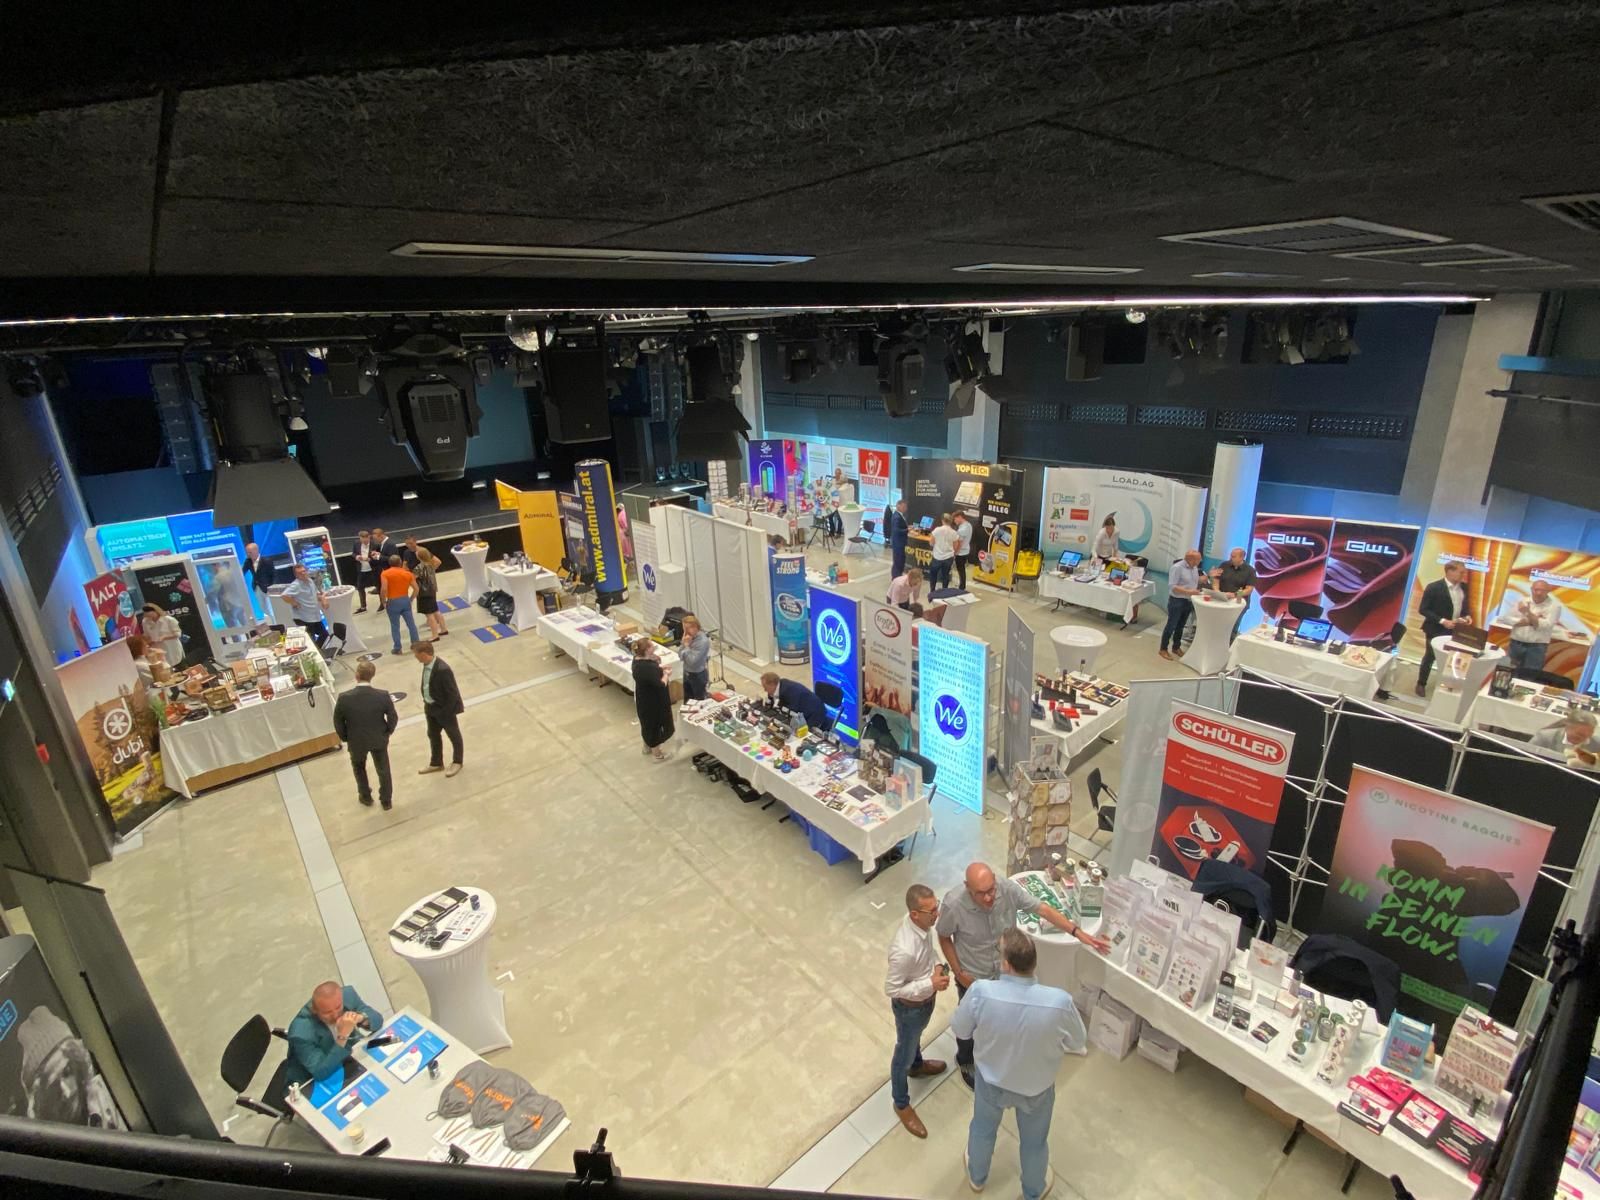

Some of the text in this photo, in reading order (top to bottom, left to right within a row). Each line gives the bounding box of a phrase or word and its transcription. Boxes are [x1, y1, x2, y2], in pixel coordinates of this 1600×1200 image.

[955, 464, 970, 473] TOP
[578, 471, 607, 583] www.admiral.at
[1050, 507, 1065, 520] A1
[822, 621, 844, 648] We
[936, 700, 964, 730] We
[113, 735, 145, 764] dubi
[1180, 717, 1279, 760] SCHÜLLER
[1395, 798, 1522, 847] NICOTINE BAGGIES
[1375, 863, 1467, 911] KOMM
[1338, 876, 1500, 946] IN DEINEN
